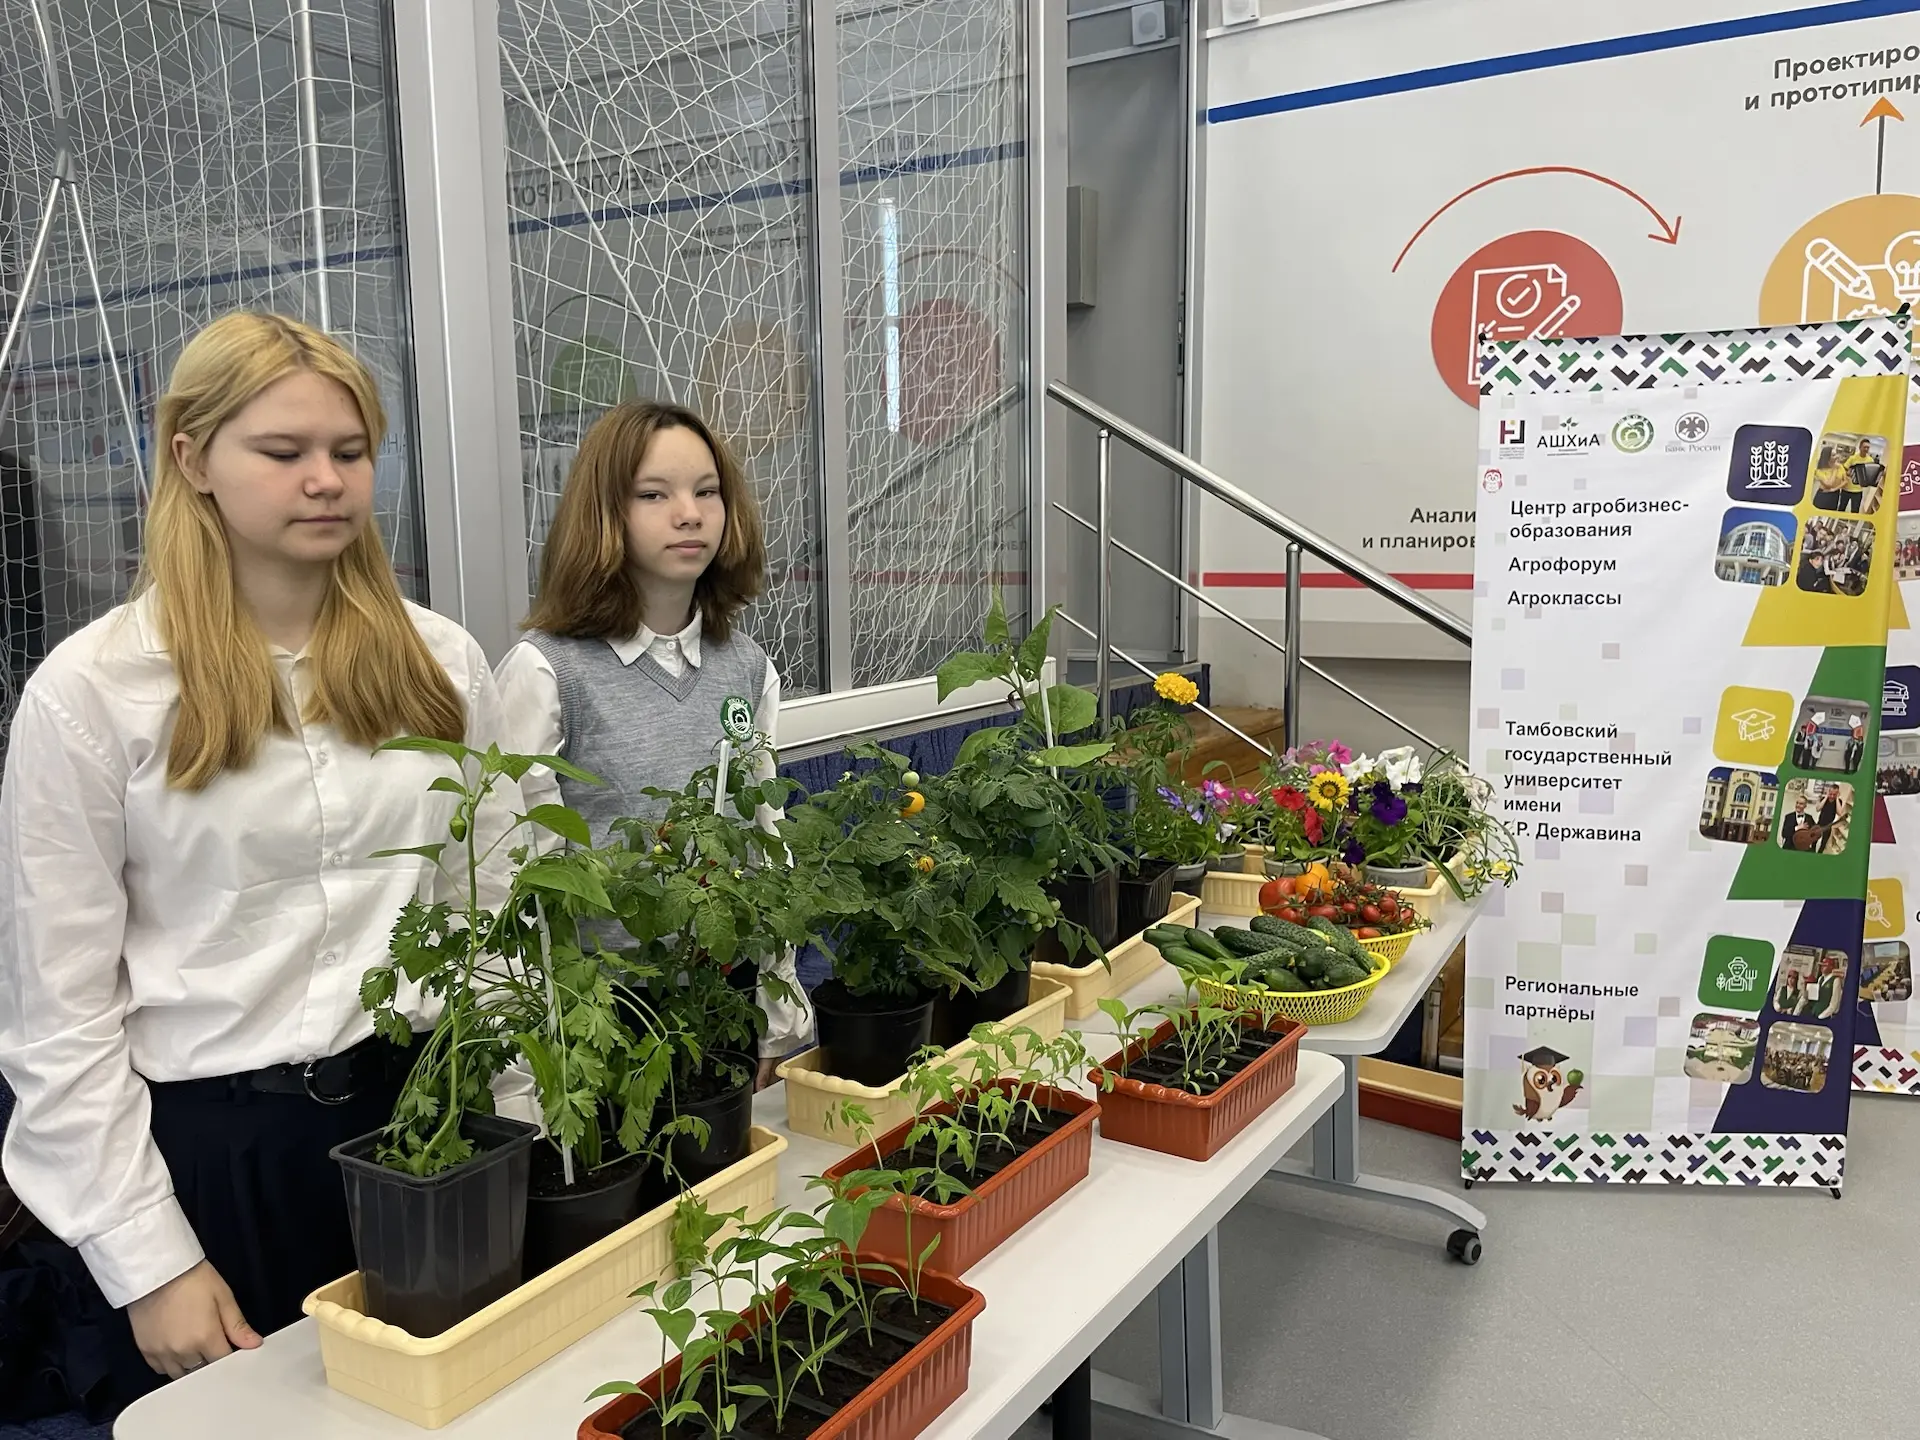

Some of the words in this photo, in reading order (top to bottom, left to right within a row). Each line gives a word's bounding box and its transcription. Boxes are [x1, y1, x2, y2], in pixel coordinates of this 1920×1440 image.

[1774, 45, 1920, 82] Проектиро
[1744, 94, 1760, 111] и
[1536, 433, 1601, 448] АШХиА
[1664, 445, 1686, 453] Банк
[1688, 444, 1721, 453] России
[1409, 507, 1476, 523] Анали
[1510, 500, 1566, 518] Центр
[1572, 497, 1690, 517] агробизнес-
[1509, 523, 1633, 542] образования
[1362, 536, 1373, 549] и
[1508, 556, 1617, 575] Агрофорум
[1507, 590, 1622, 609] Агроклассы
[1505, 720, 1618, 739] Тамбовский
[1504, 749, 1673, 767] государственный
[1504, 774, 1623, 791] университет
[1503, 799, 1562, 813] имени
[1535, 822, 1642, 842] Державина
[1505, 975, 1639, 997] Региональные
[1504, 1003, 1595, 1023] партнёры
